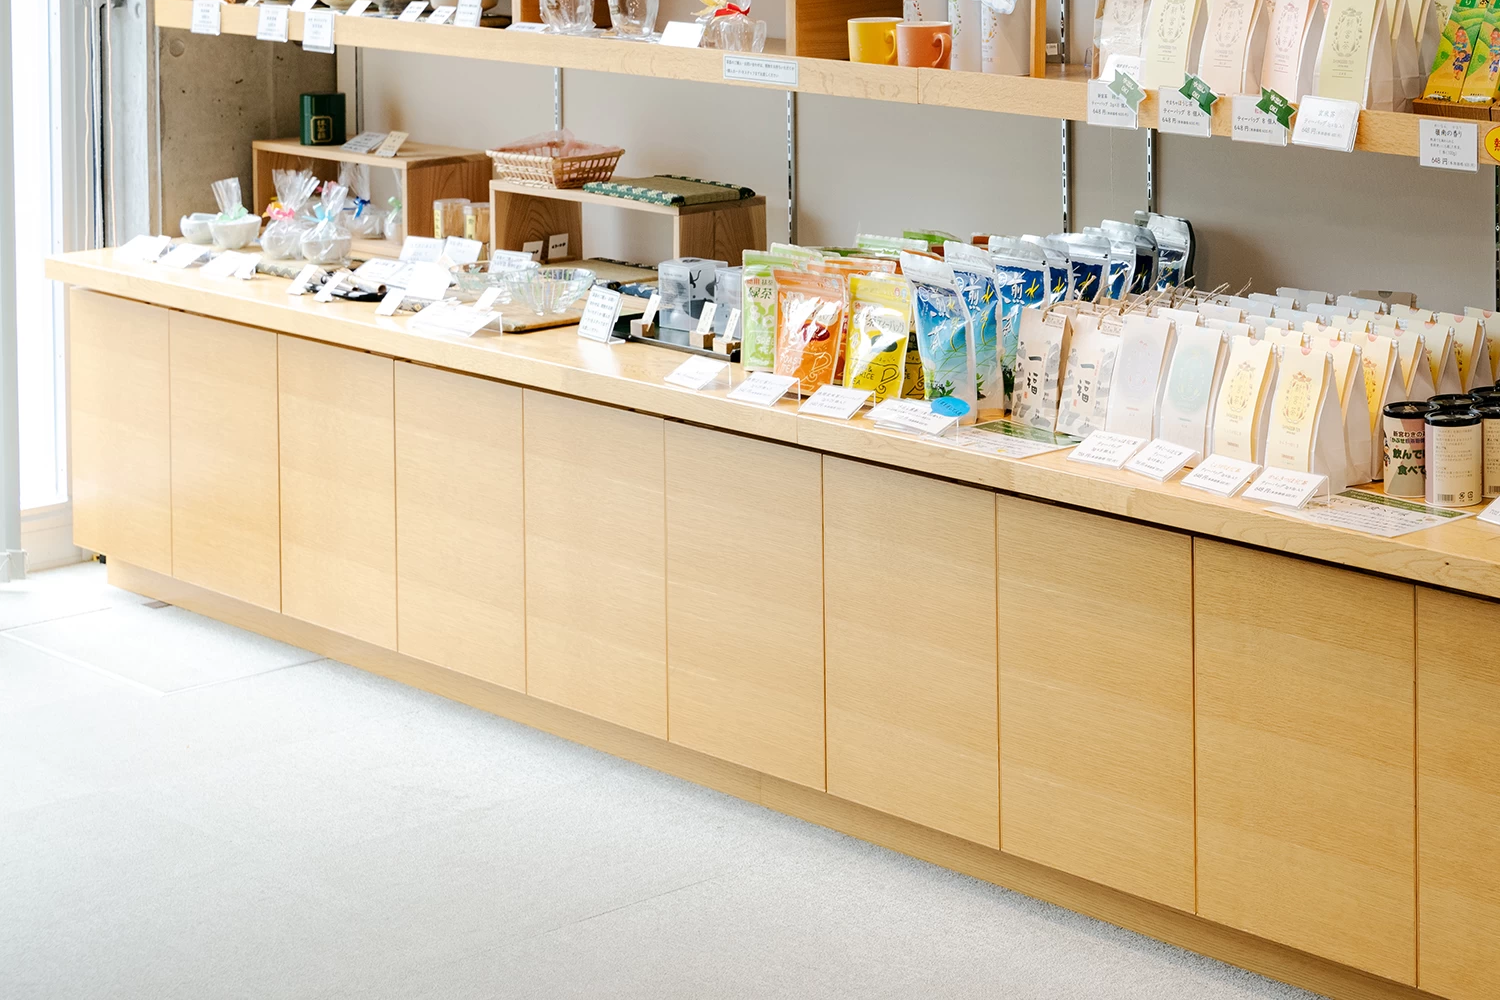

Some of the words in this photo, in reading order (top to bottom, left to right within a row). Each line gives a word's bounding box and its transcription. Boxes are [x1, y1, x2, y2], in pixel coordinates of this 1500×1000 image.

[749, 287, 773, 300] 緑茶
[1027, 356, 1042, 395] 一福
[1078, 364, 1095, 403] 一福
